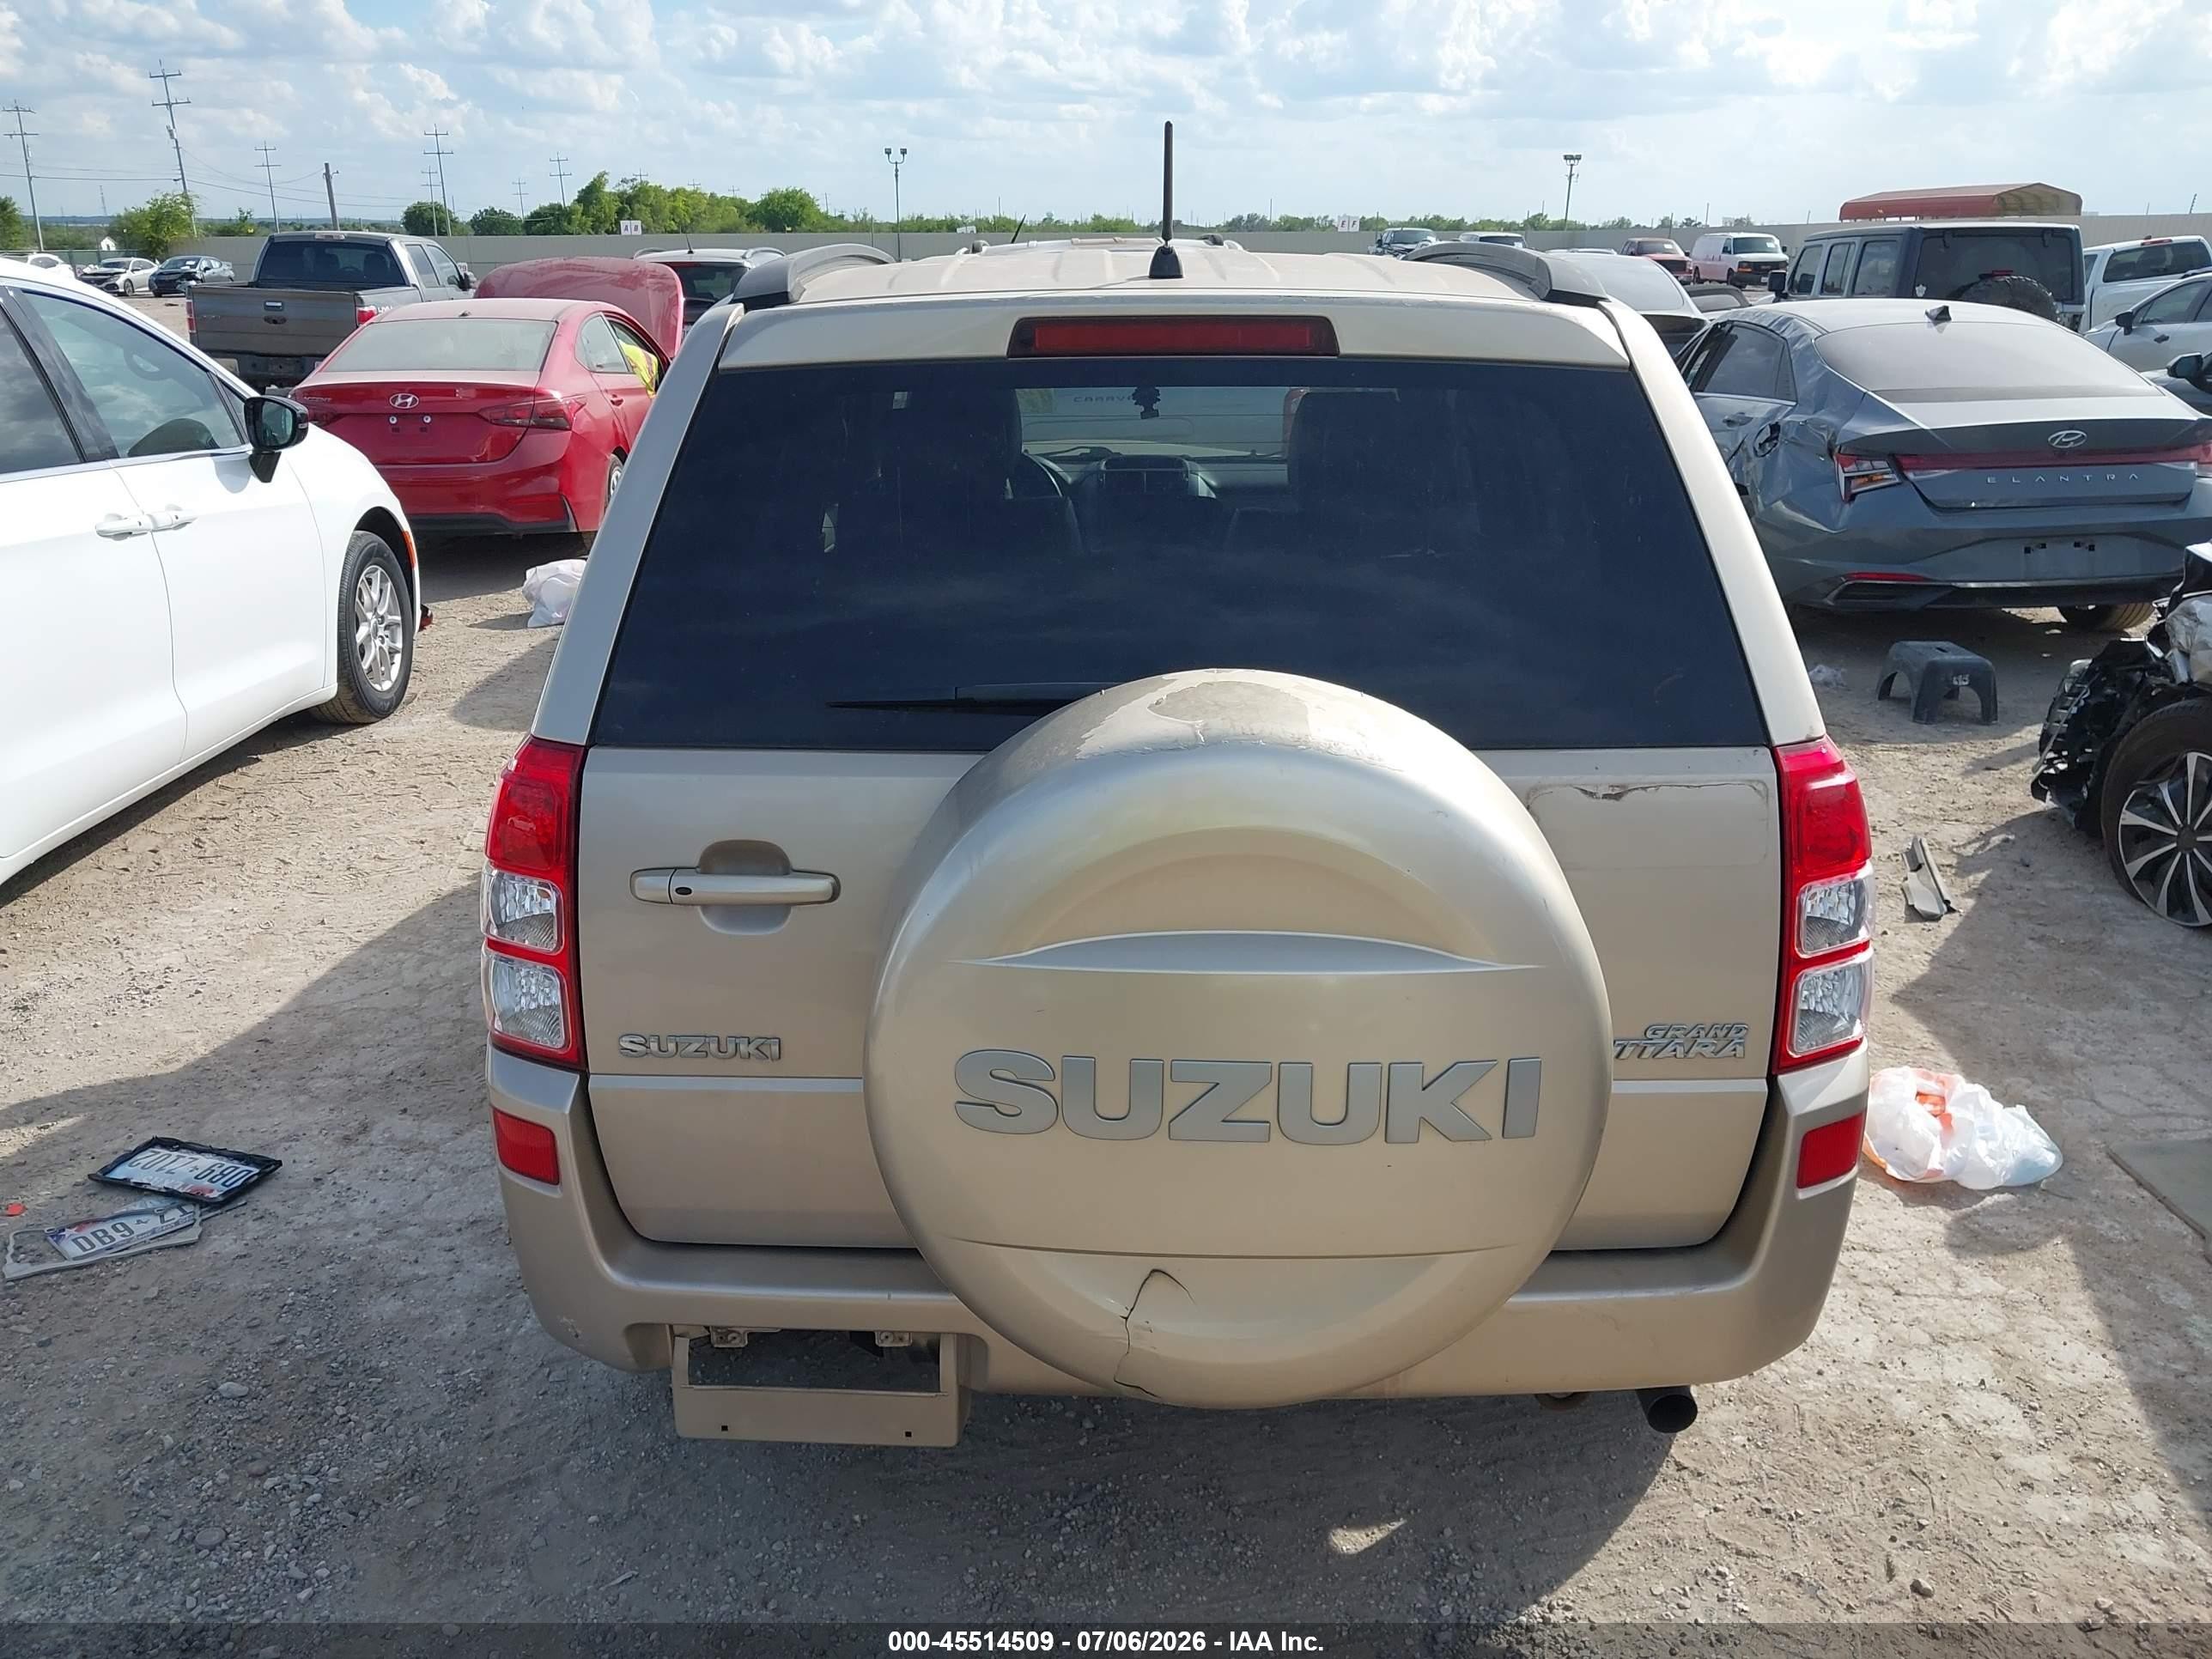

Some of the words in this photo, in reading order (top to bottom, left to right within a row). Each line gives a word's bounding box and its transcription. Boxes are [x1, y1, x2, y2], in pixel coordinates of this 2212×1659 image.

[1987, 473, 2139, 483] ELANTRA
[1644, 1024, 1749, 1039] GRAND
[618, 1034, 781, 1061] SUZUKI
[954, 1048, 1542, 1146] SUZUKI
[71, 1222, 135, 1253] DB9
